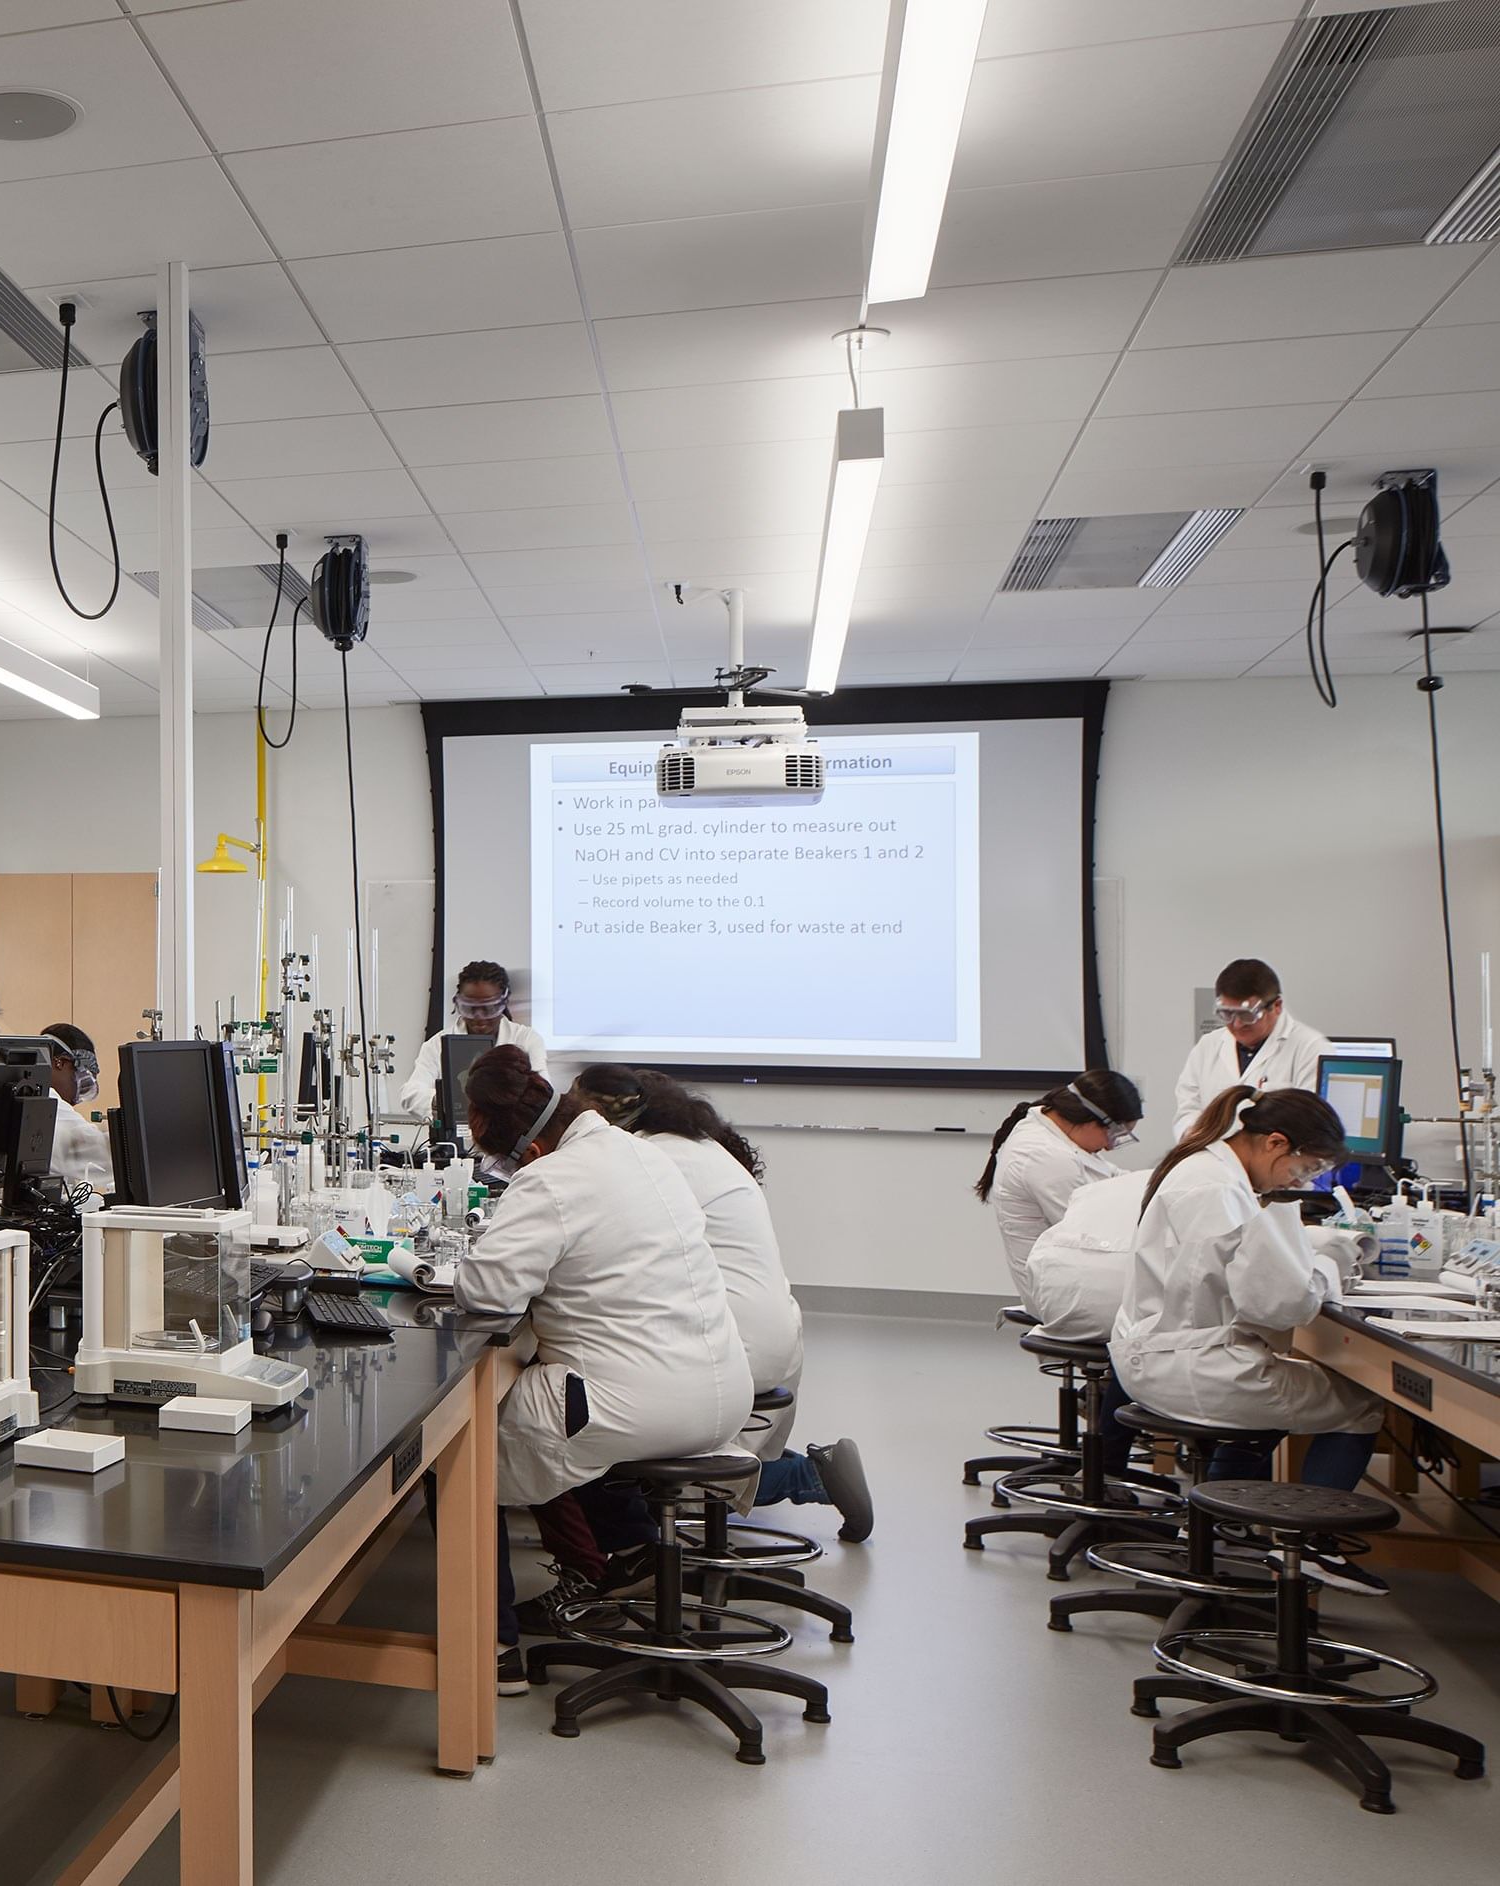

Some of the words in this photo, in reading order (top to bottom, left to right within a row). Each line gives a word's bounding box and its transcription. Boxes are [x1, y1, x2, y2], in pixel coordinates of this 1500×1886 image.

[608, 761, 657, 777] Equip
[825, 755, 892, 770] rmation
[726, 768, 751, 776] EPSON
[573, 795, 614, 809] Work
[620, 795, 633, 809] in
[573, 822, 602, 836] Use
[607, 822, 626, 836] 25
[631, 821, 653, 835] mL
[658, 820, 697, 837] grad.
[703, 819, 766, 837] cylinder
[771, 821, 788, 833] to
[793, 820, 863, 833] measure
[868, 819, 897, 832] out
[575, 848, 620, 862] NaOH
[625, 847, 654, 862] and
[659, 847, 680, 861] CV
[685, 847, 716, 861] into
[720, 848, 789, 863] separate
[795, 845, 858, 860] Beakers
[863, 846, 872, 859] 1
[877, 844, 909, 859] and
[915, 845, 924, 859] 2
[592, 875, 618, 885] Use
[622, 874, 663, 887] pipets
[667, 876, 682, 885] as
[687, 872, 738, 884] needed
[592, 896, 639, 908] Record
[643, 896, 694, 908] volume
[699, 897, 713, 907] to
[717, 896, 740, 907] the
[744, 896, 765, 907] 0.1
[574, 920, 600, 933] Put
[604, 920, 645, 933] aside
[650, 920, 702, 933] Beaker
[708, 919, 722, 935] 3,
[727, 919, 764, 933] used
[770, 919, 792, 933] for
[797, 922, 845, 933] waste
[850, 922, 866, 933] at
[871, 919, 902, 933] end
